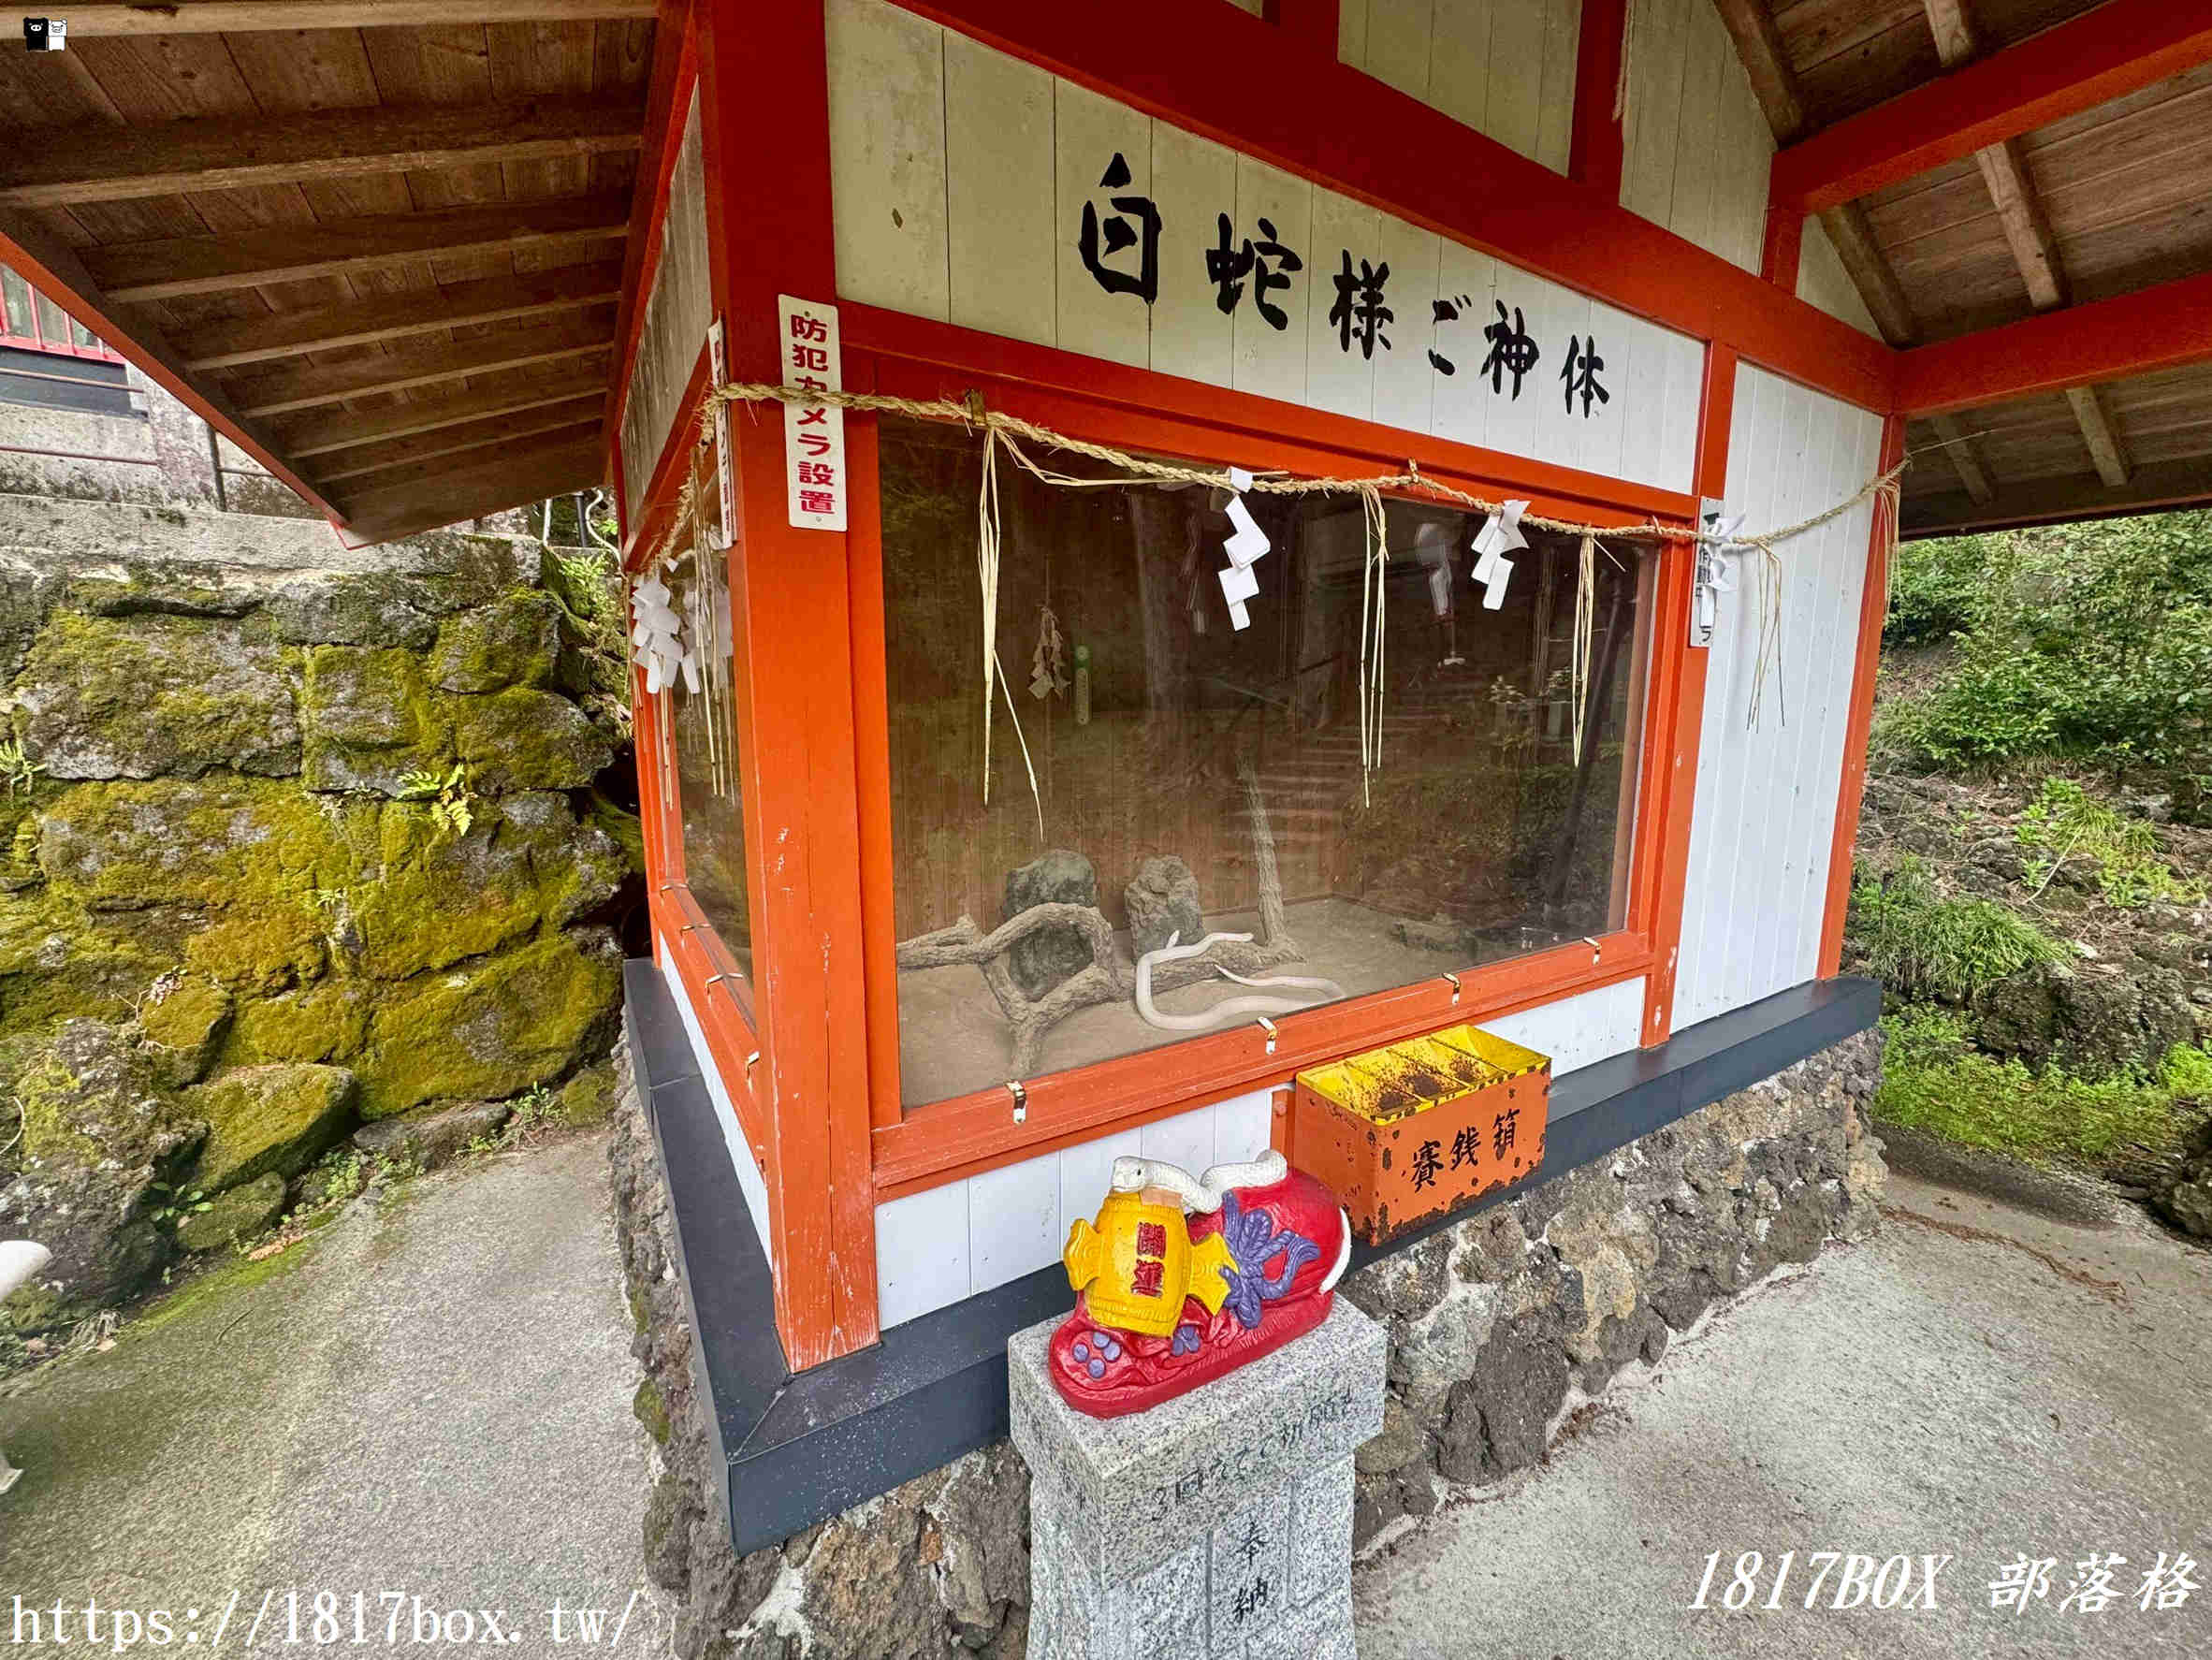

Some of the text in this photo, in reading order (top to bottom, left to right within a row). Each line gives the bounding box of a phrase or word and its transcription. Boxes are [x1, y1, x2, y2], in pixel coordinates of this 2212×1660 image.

[1078, 152, 1611, 419] 白蛇様ご神体
[790, 313, 836, 515] 防犯カメラ設置
[1410, 1108, 1521, 1194] 賽銭箱
